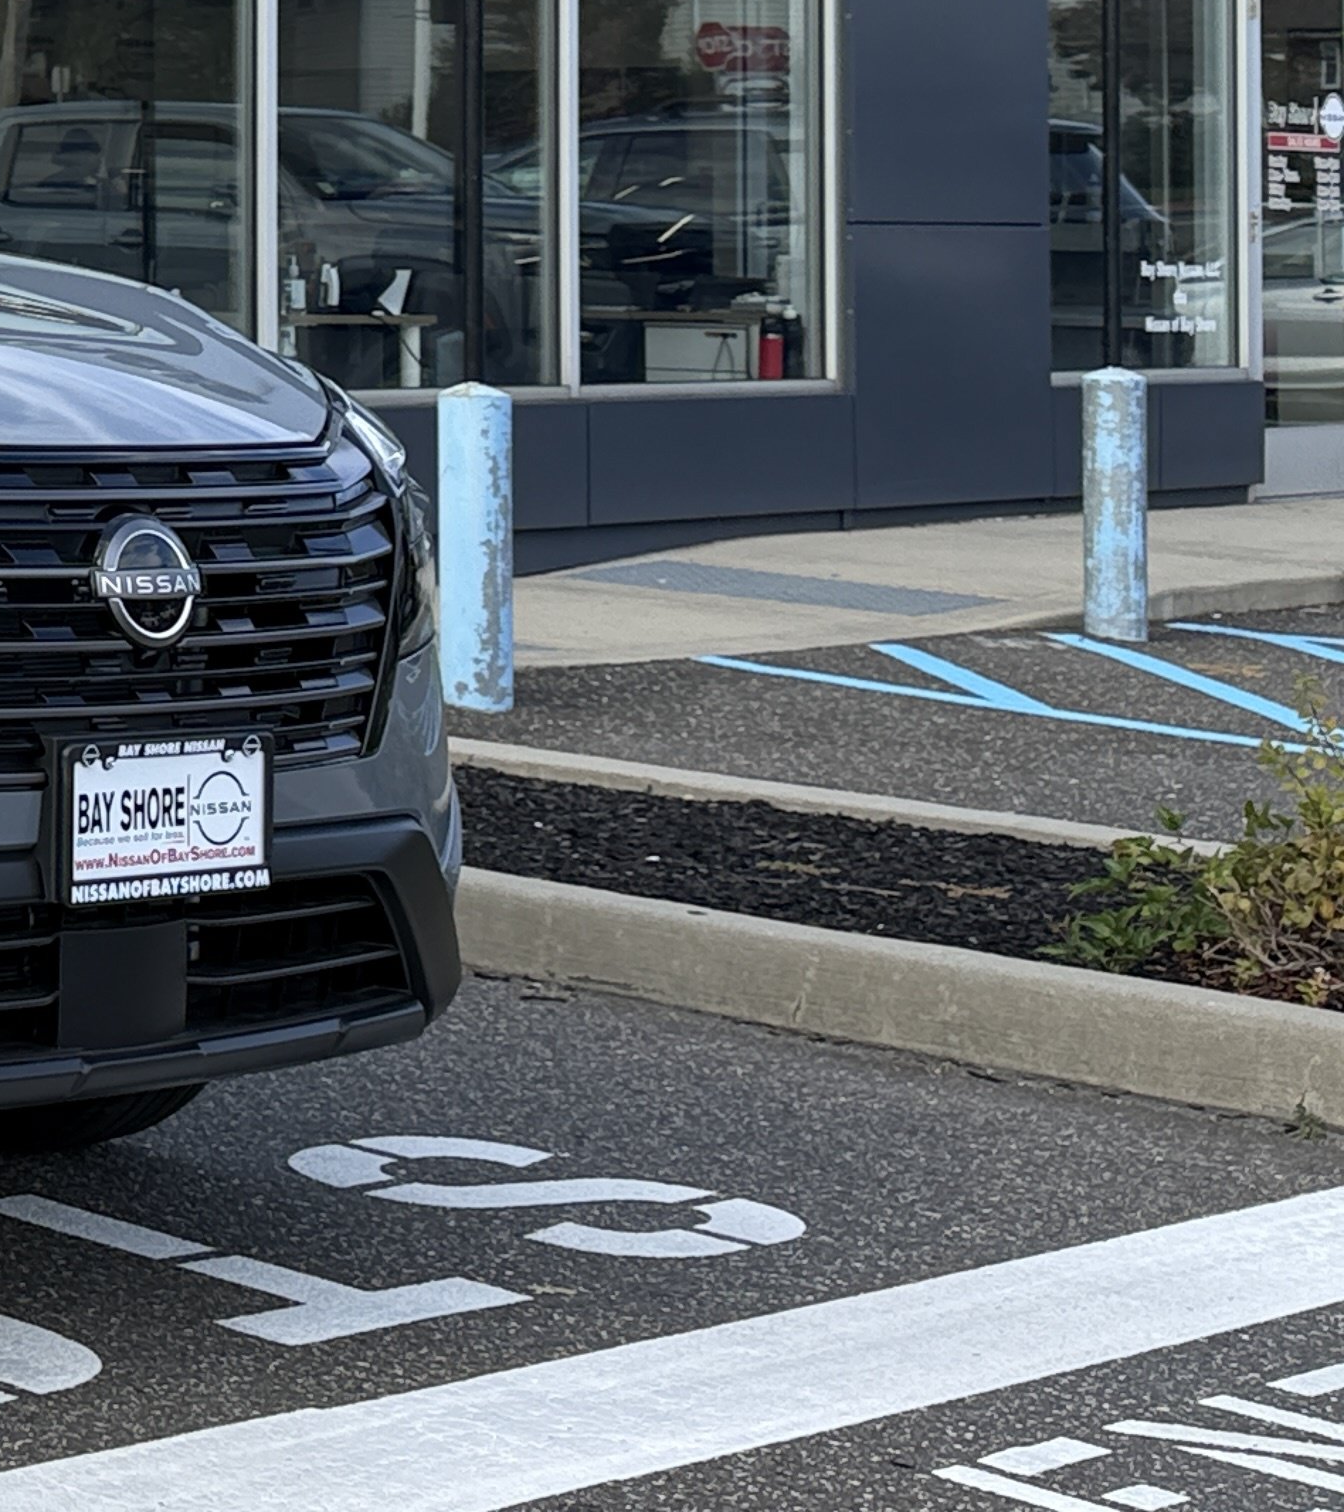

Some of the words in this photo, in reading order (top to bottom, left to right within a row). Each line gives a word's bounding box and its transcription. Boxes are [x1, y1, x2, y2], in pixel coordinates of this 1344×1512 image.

[100, 573, 201, 595] NISSAN
[117, 743, 141, 758] BAY
[143, 741, 181, 757] SHORE
[183, 738, 226, 754] NISSAN
[77, 791, 115, 835] BAY
[120, 786, 185, 832] SHORE
[190, 800, 252, 817] NISSAN
[70, 868, 271, 905] NISSANOFBAYSHORE.COM
